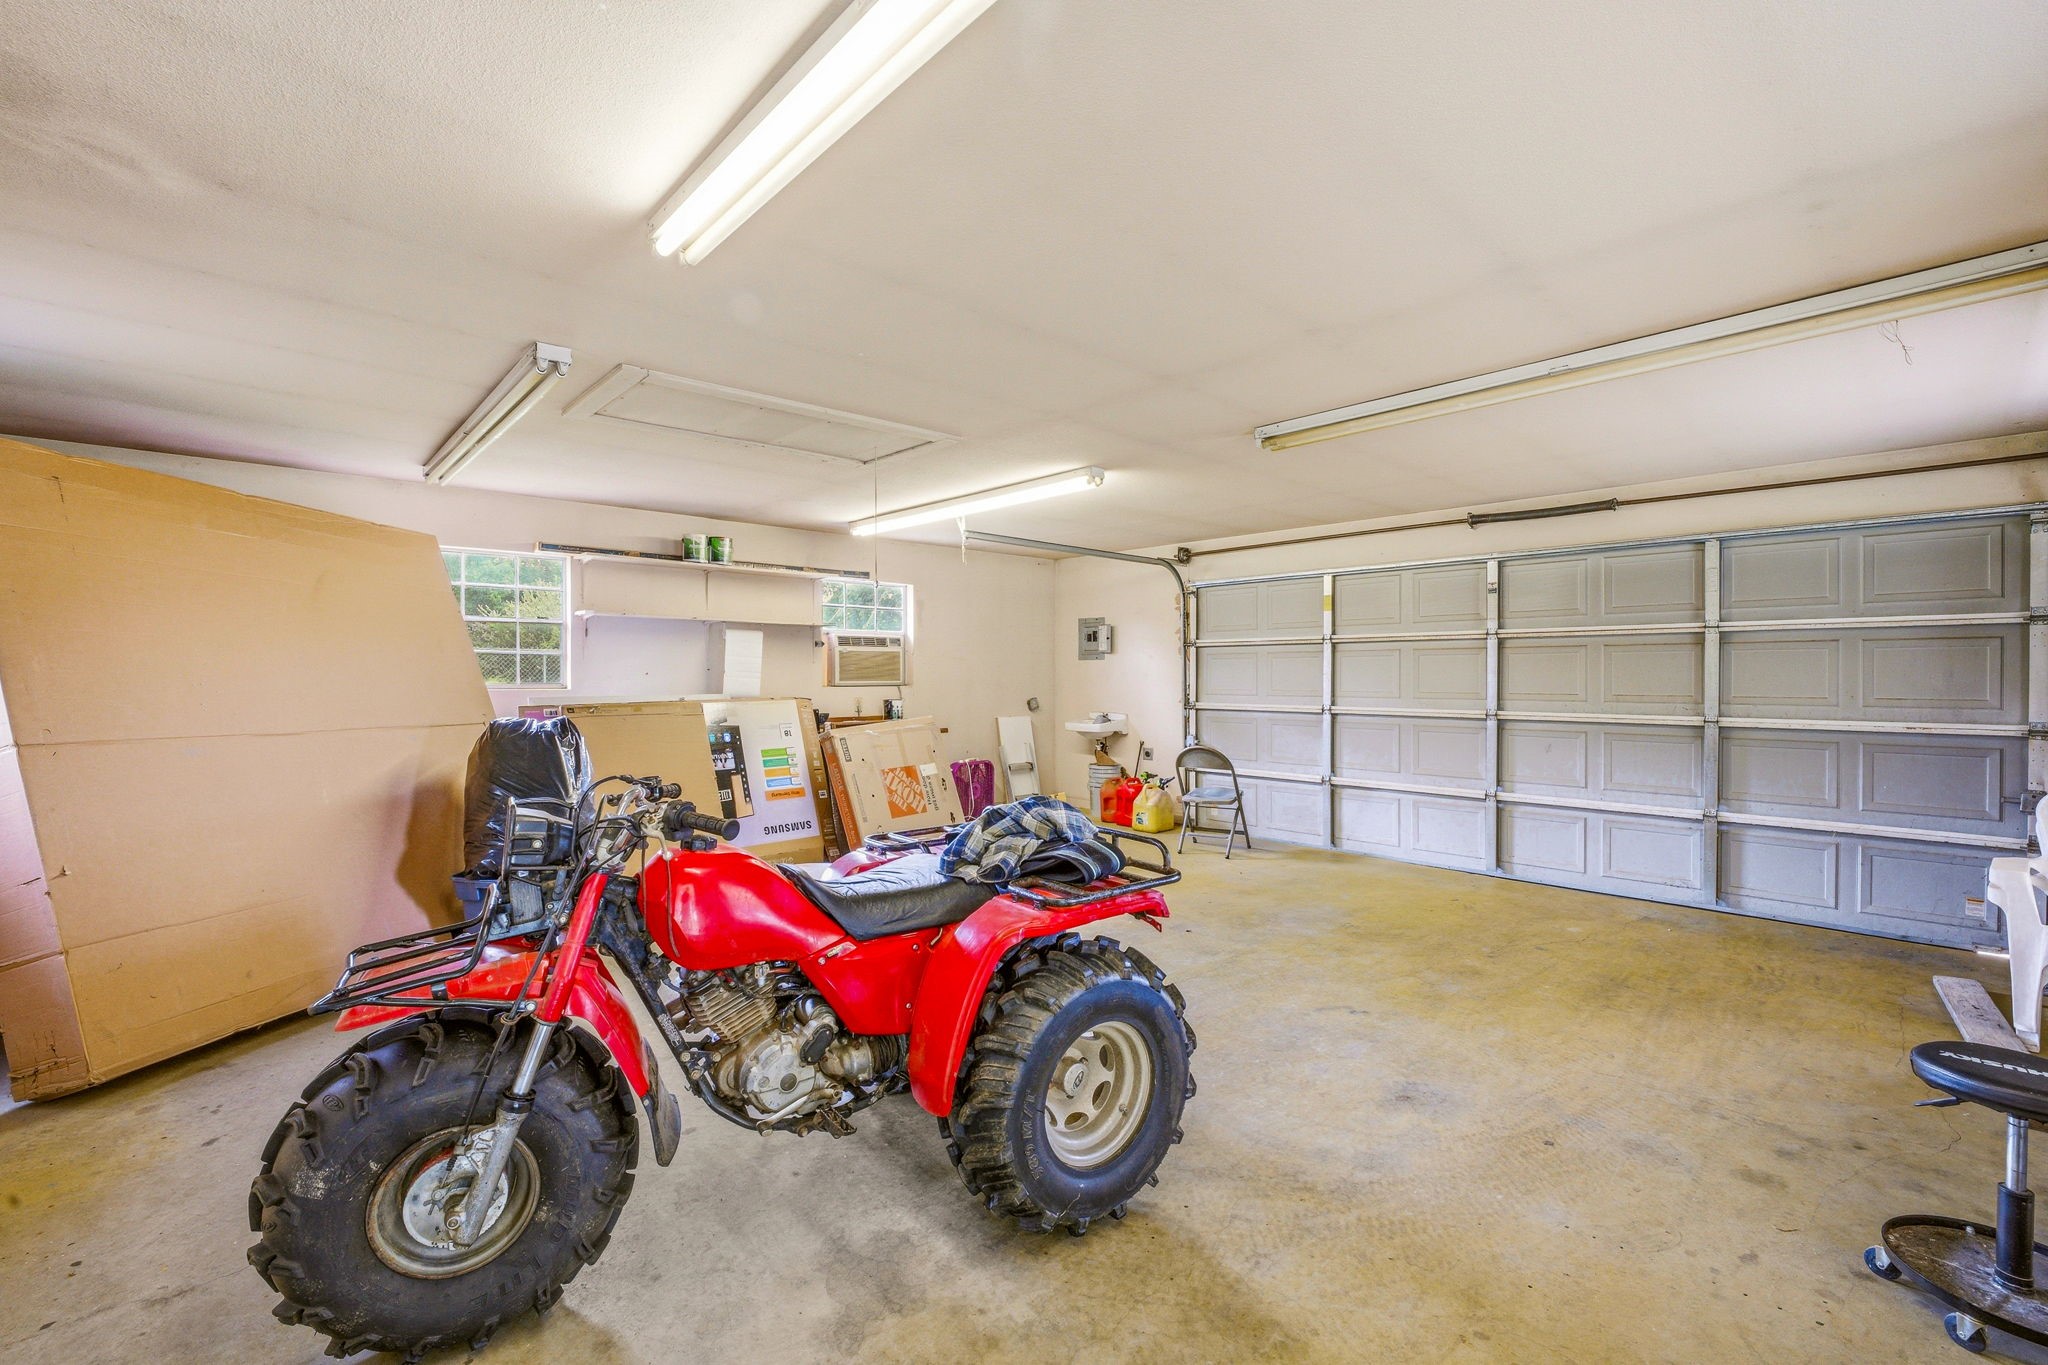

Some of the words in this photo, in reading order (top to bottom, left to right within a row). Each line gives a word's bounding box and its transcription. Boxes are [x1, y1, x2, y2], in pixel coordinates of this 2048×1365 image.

[883, 770, 925, 813] HOME
[894, 767, 921, 793] DEPOT
[763, 820, 812, 835] SAMSUNG
